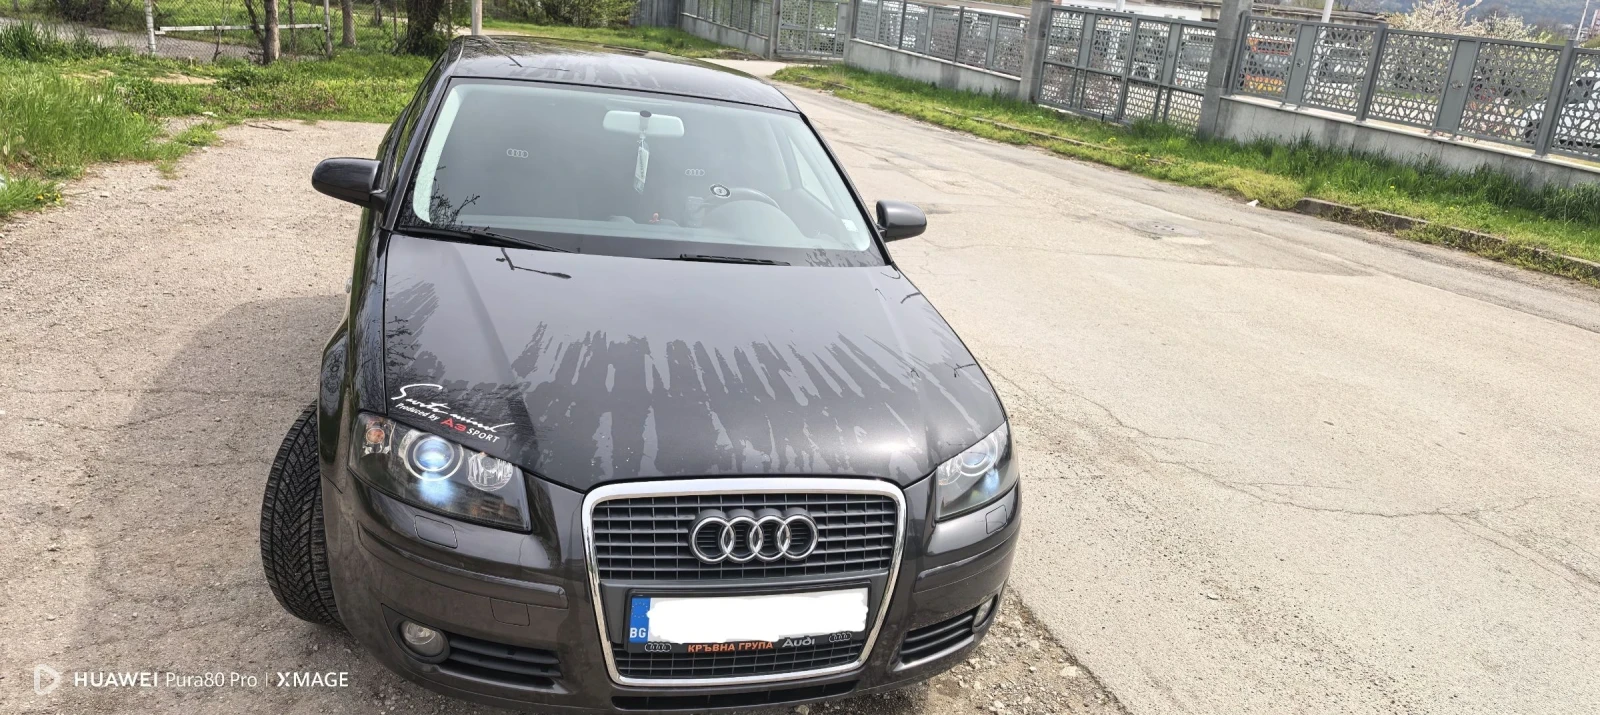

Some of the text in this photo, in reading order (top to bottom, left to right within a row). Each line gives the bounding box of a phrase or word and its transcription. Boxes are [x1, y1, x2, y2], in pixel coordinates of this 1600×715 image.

[395, 402, 500, 444] Produced by A3 SPORT
[629, 627, 647, 639] BG
[687, 636, 816, 653] КРЪВНА ГРУПА Audi
